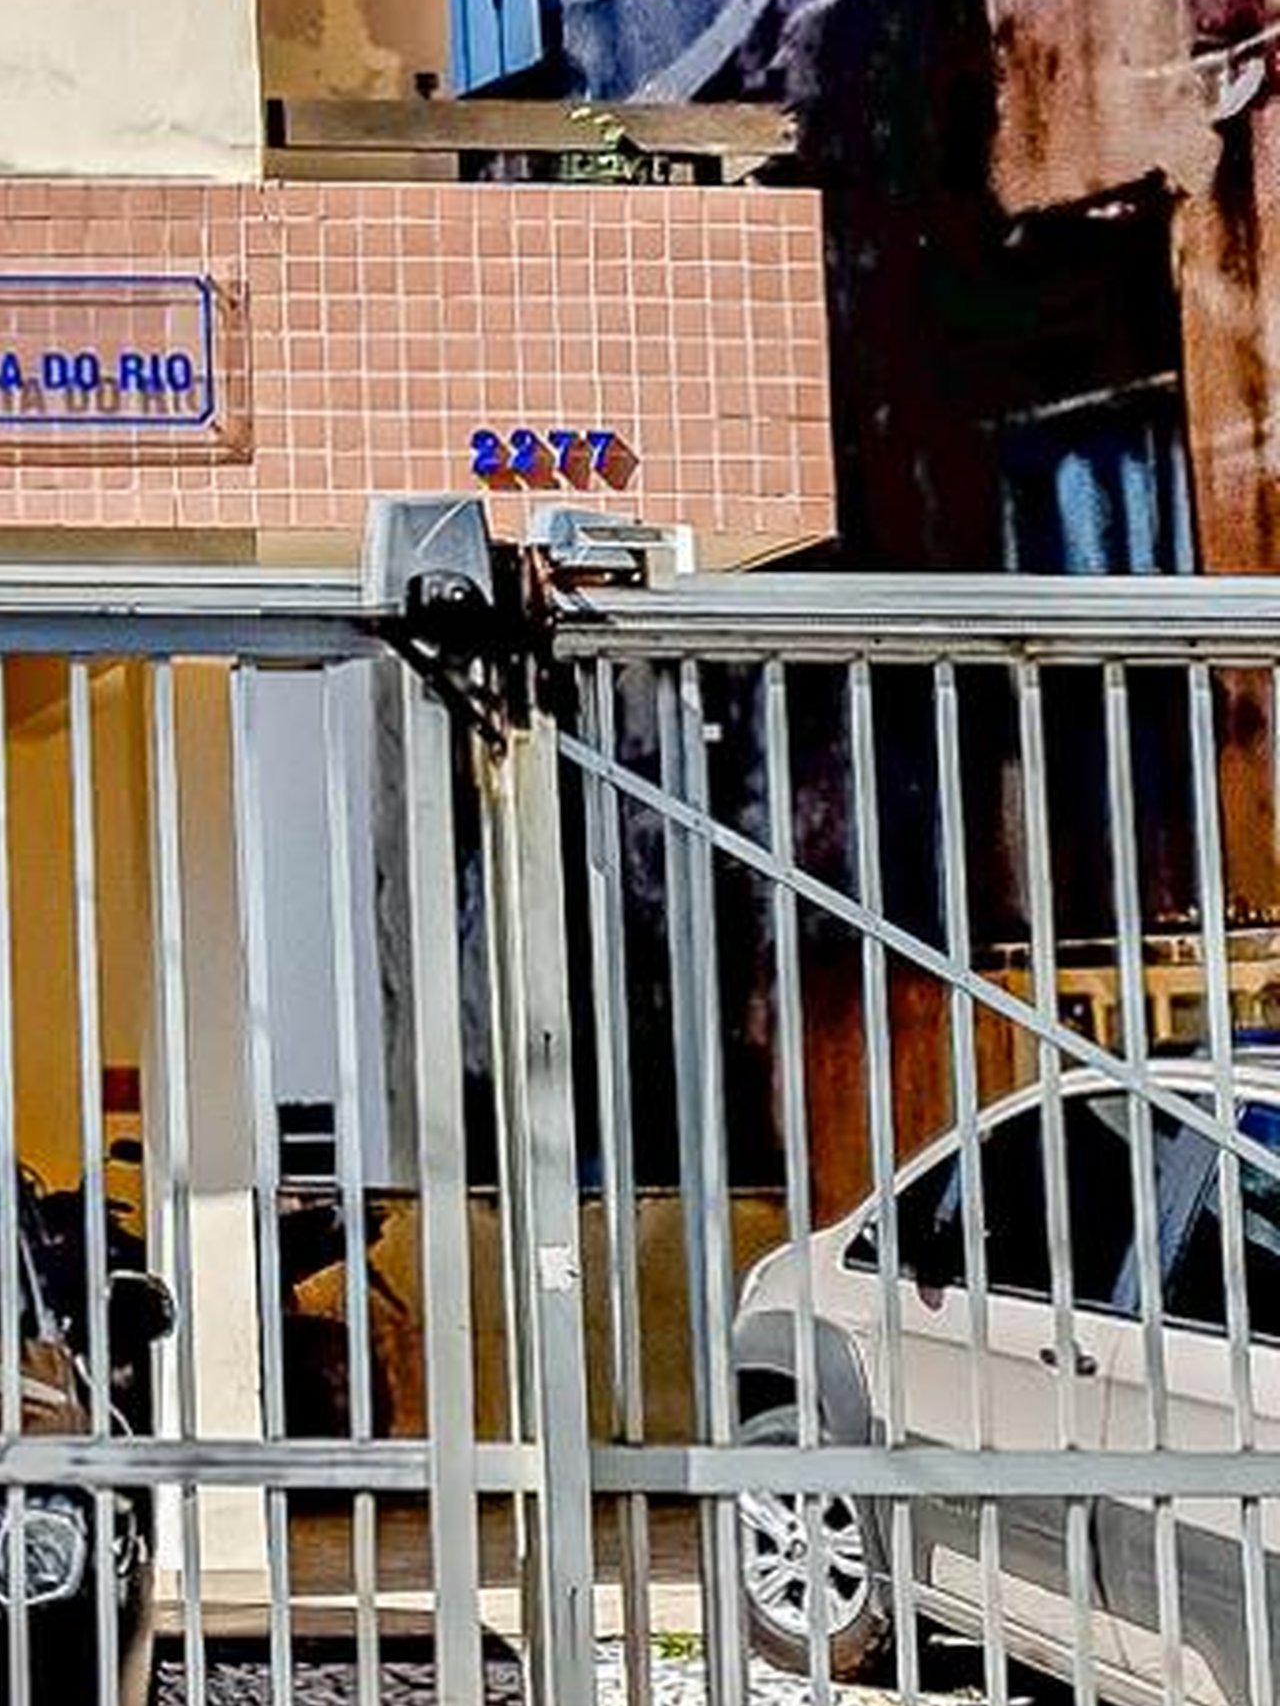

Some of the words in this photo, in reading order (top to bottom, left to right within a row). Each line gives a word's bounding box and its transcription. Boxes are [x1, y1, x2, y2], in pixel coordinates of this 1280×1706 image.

[44, 353, 100, 391] DO
[120, 353, 192, 391] RIO
[471, 429, 613, 475] 2277
